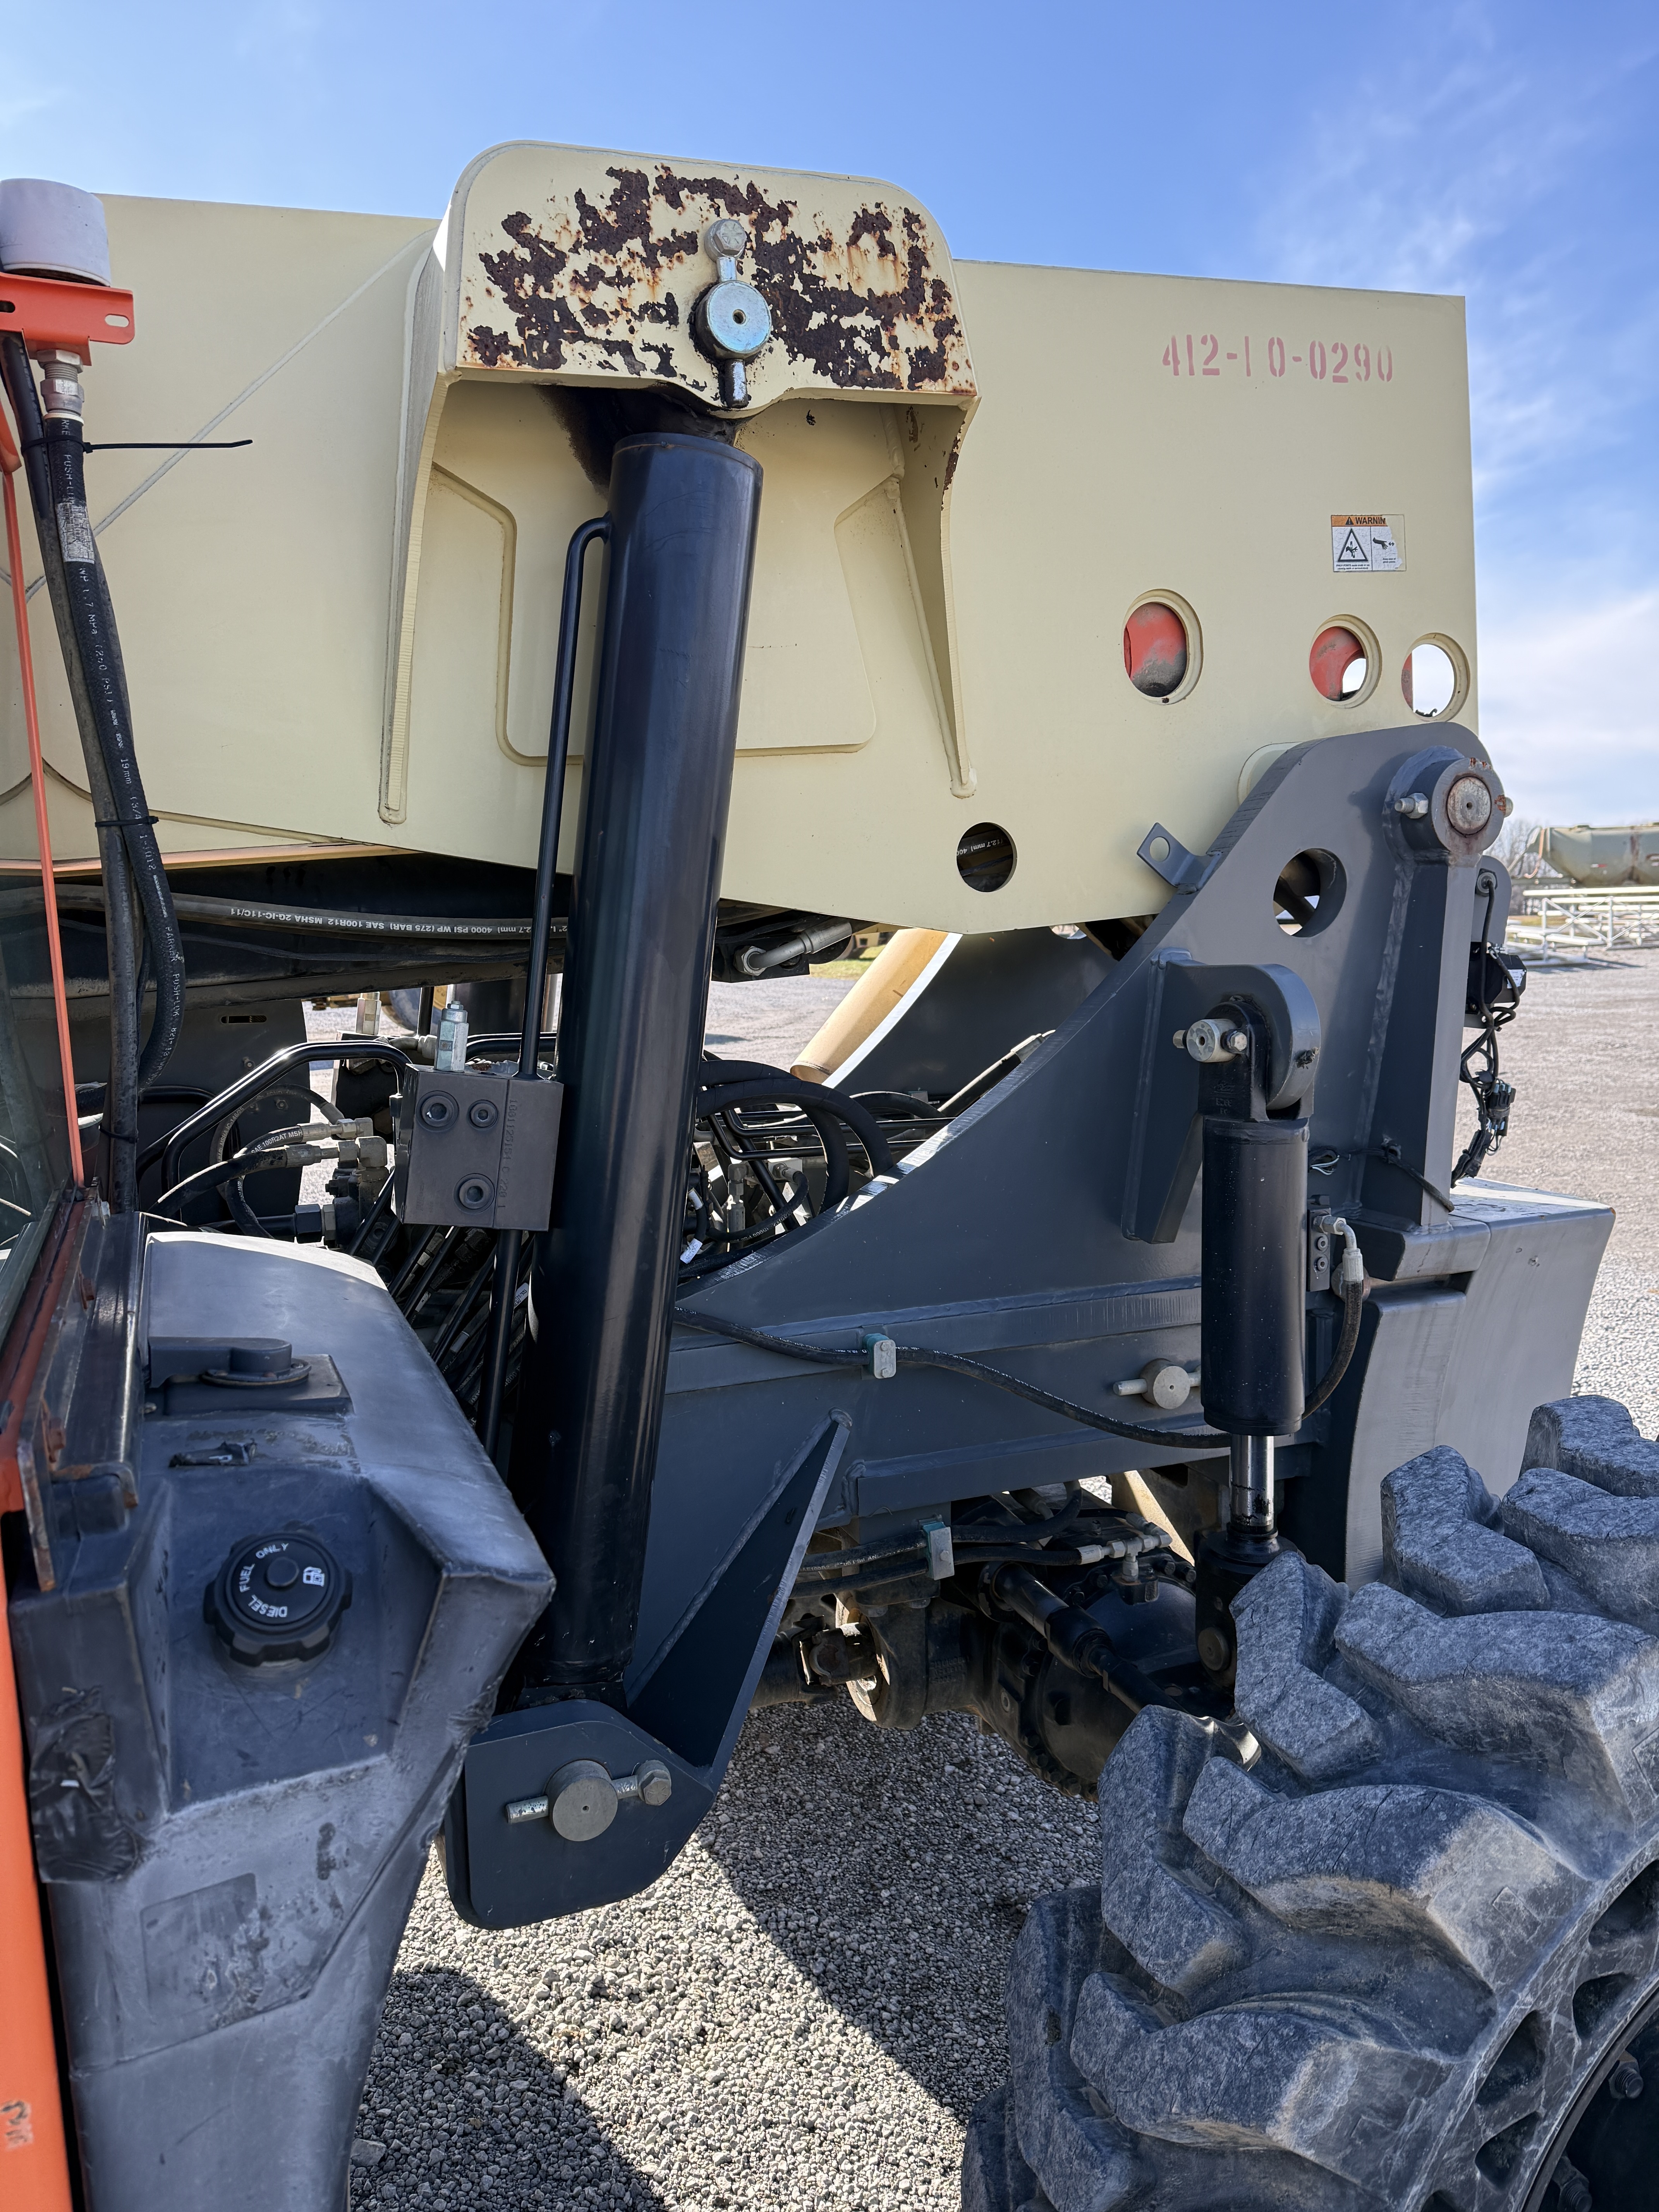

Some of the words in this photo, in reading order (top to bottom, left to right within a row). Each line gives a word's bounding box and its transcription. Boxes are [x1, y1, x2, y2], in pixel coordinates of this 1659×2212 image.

[1355, 517, 1386, 525] WARNIN
[957, 848, 968, 856] 400
[294, 915, 323, 924] MSHA
[328, 918, 363, 928] 100R12
[366, 921, 385, 929] SAE
[390, 923, 412, 932] BAR)
[415, 924, 434, 933] (275
[263, 1133, 287, 1147] 100R2AT
[288, 1130, 302, 1139] MSH
[255, 1543, 289, 1559] ONLY
[239, 1563, 256, 1593] FUEL
[248, 1595, 288, 1618] DIESEL
